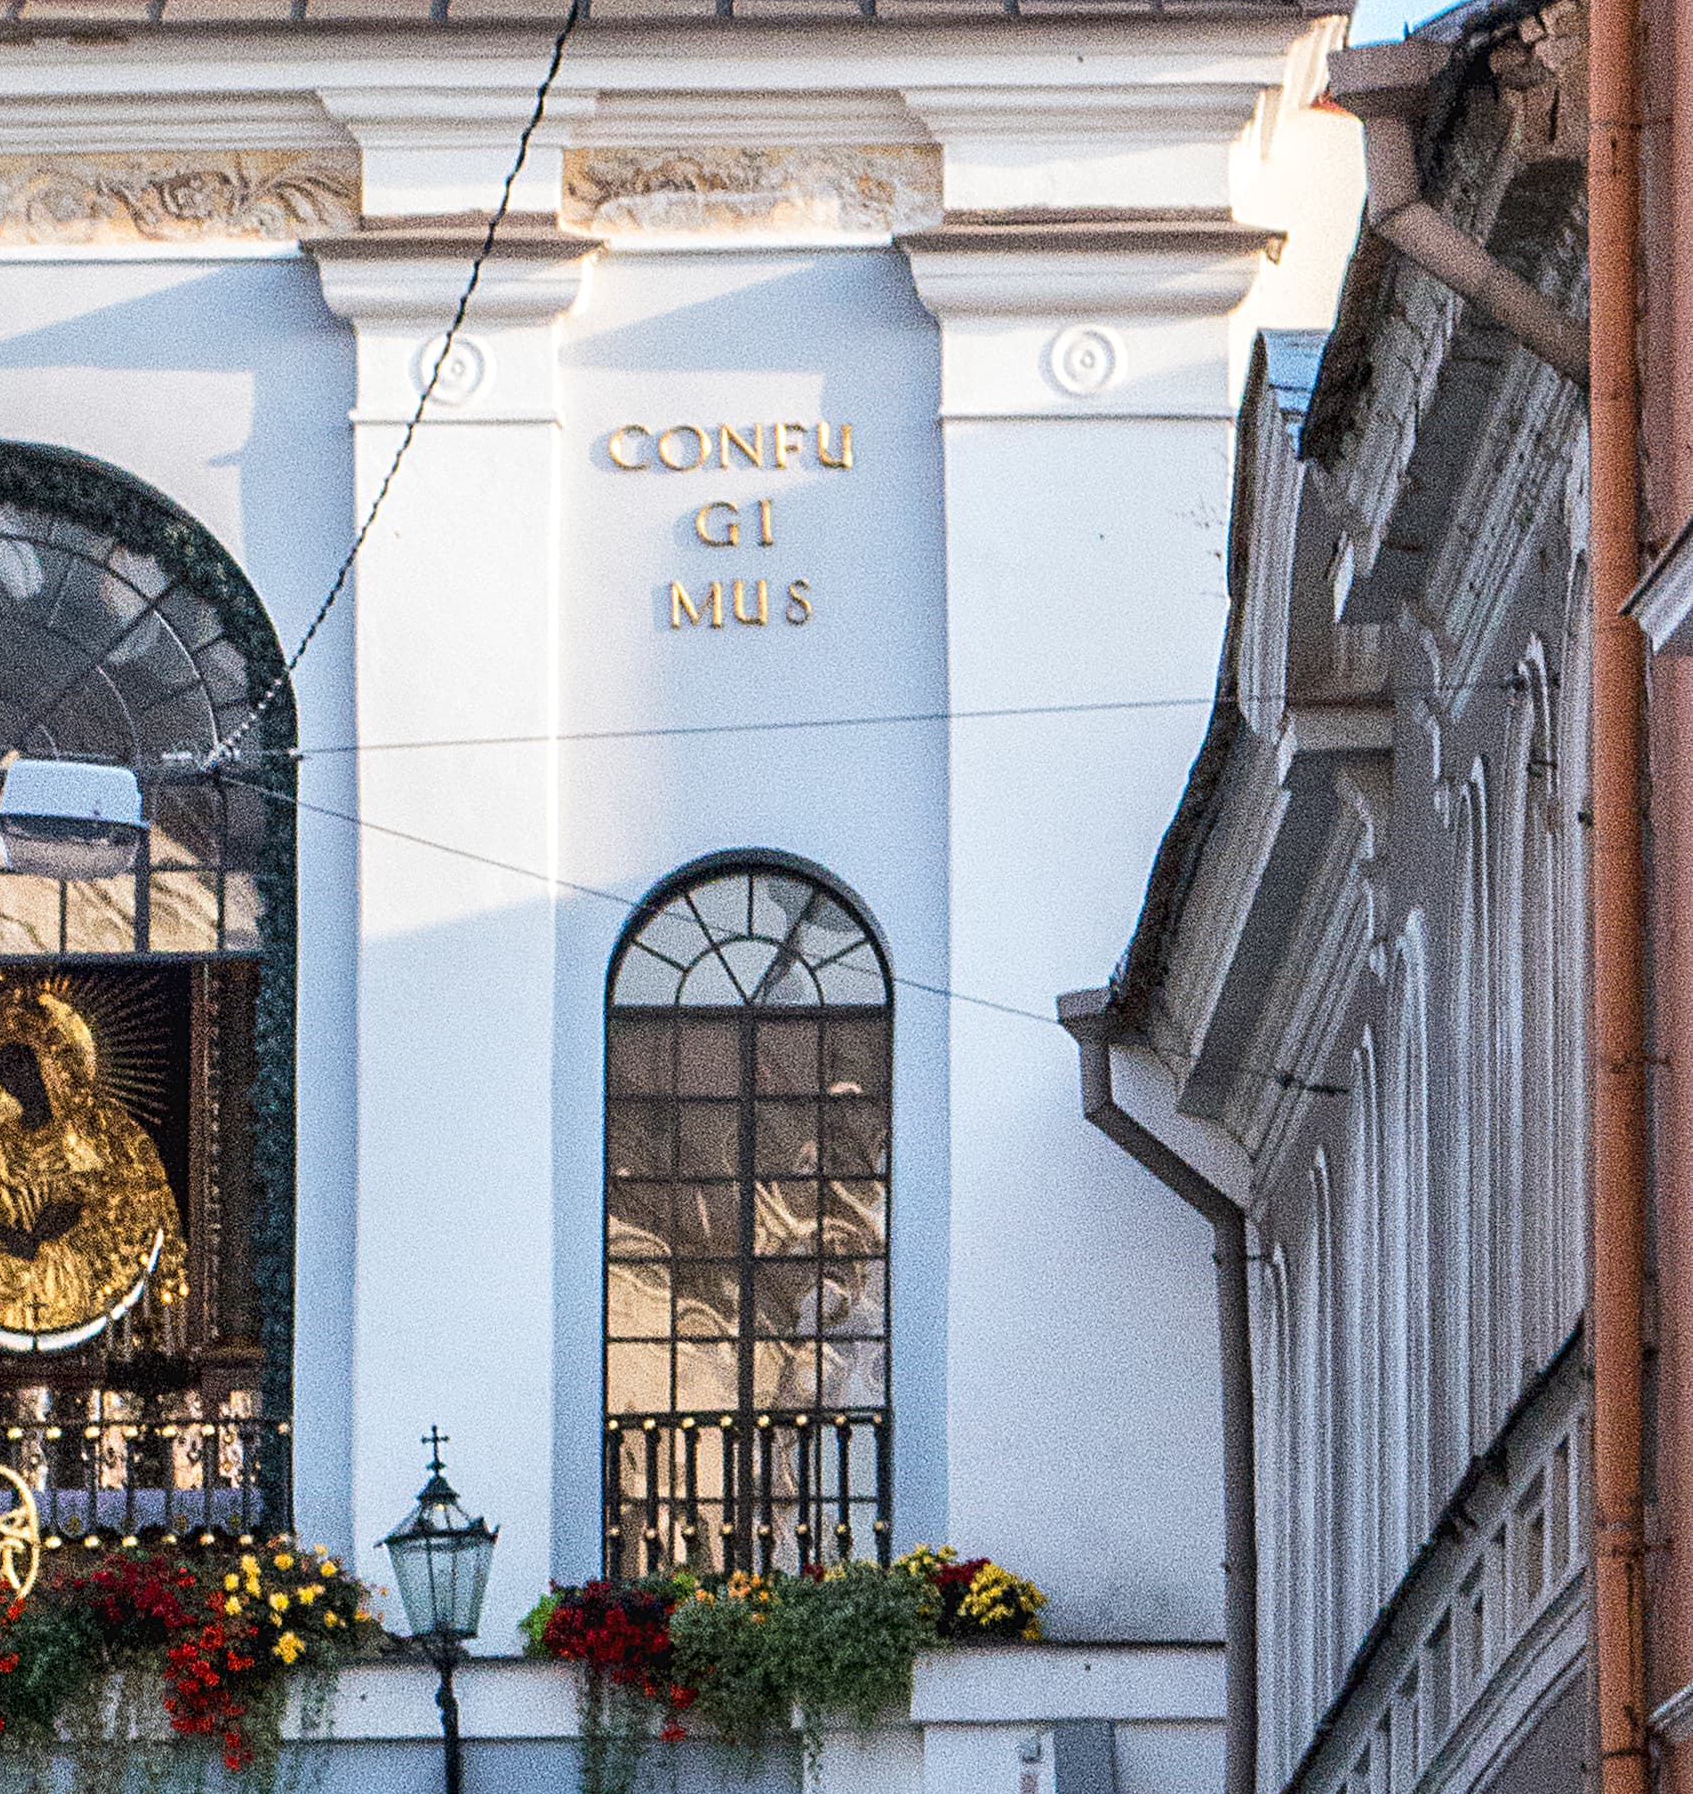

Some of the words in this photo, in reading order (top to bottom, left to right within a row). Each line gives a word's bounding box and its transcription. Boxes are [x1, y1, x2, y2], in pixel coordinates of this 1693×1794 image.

[609, 421, 852, 471] CONFU
[695, 499, 775, 548] GI
[671, 578, 813, 629] MUS
